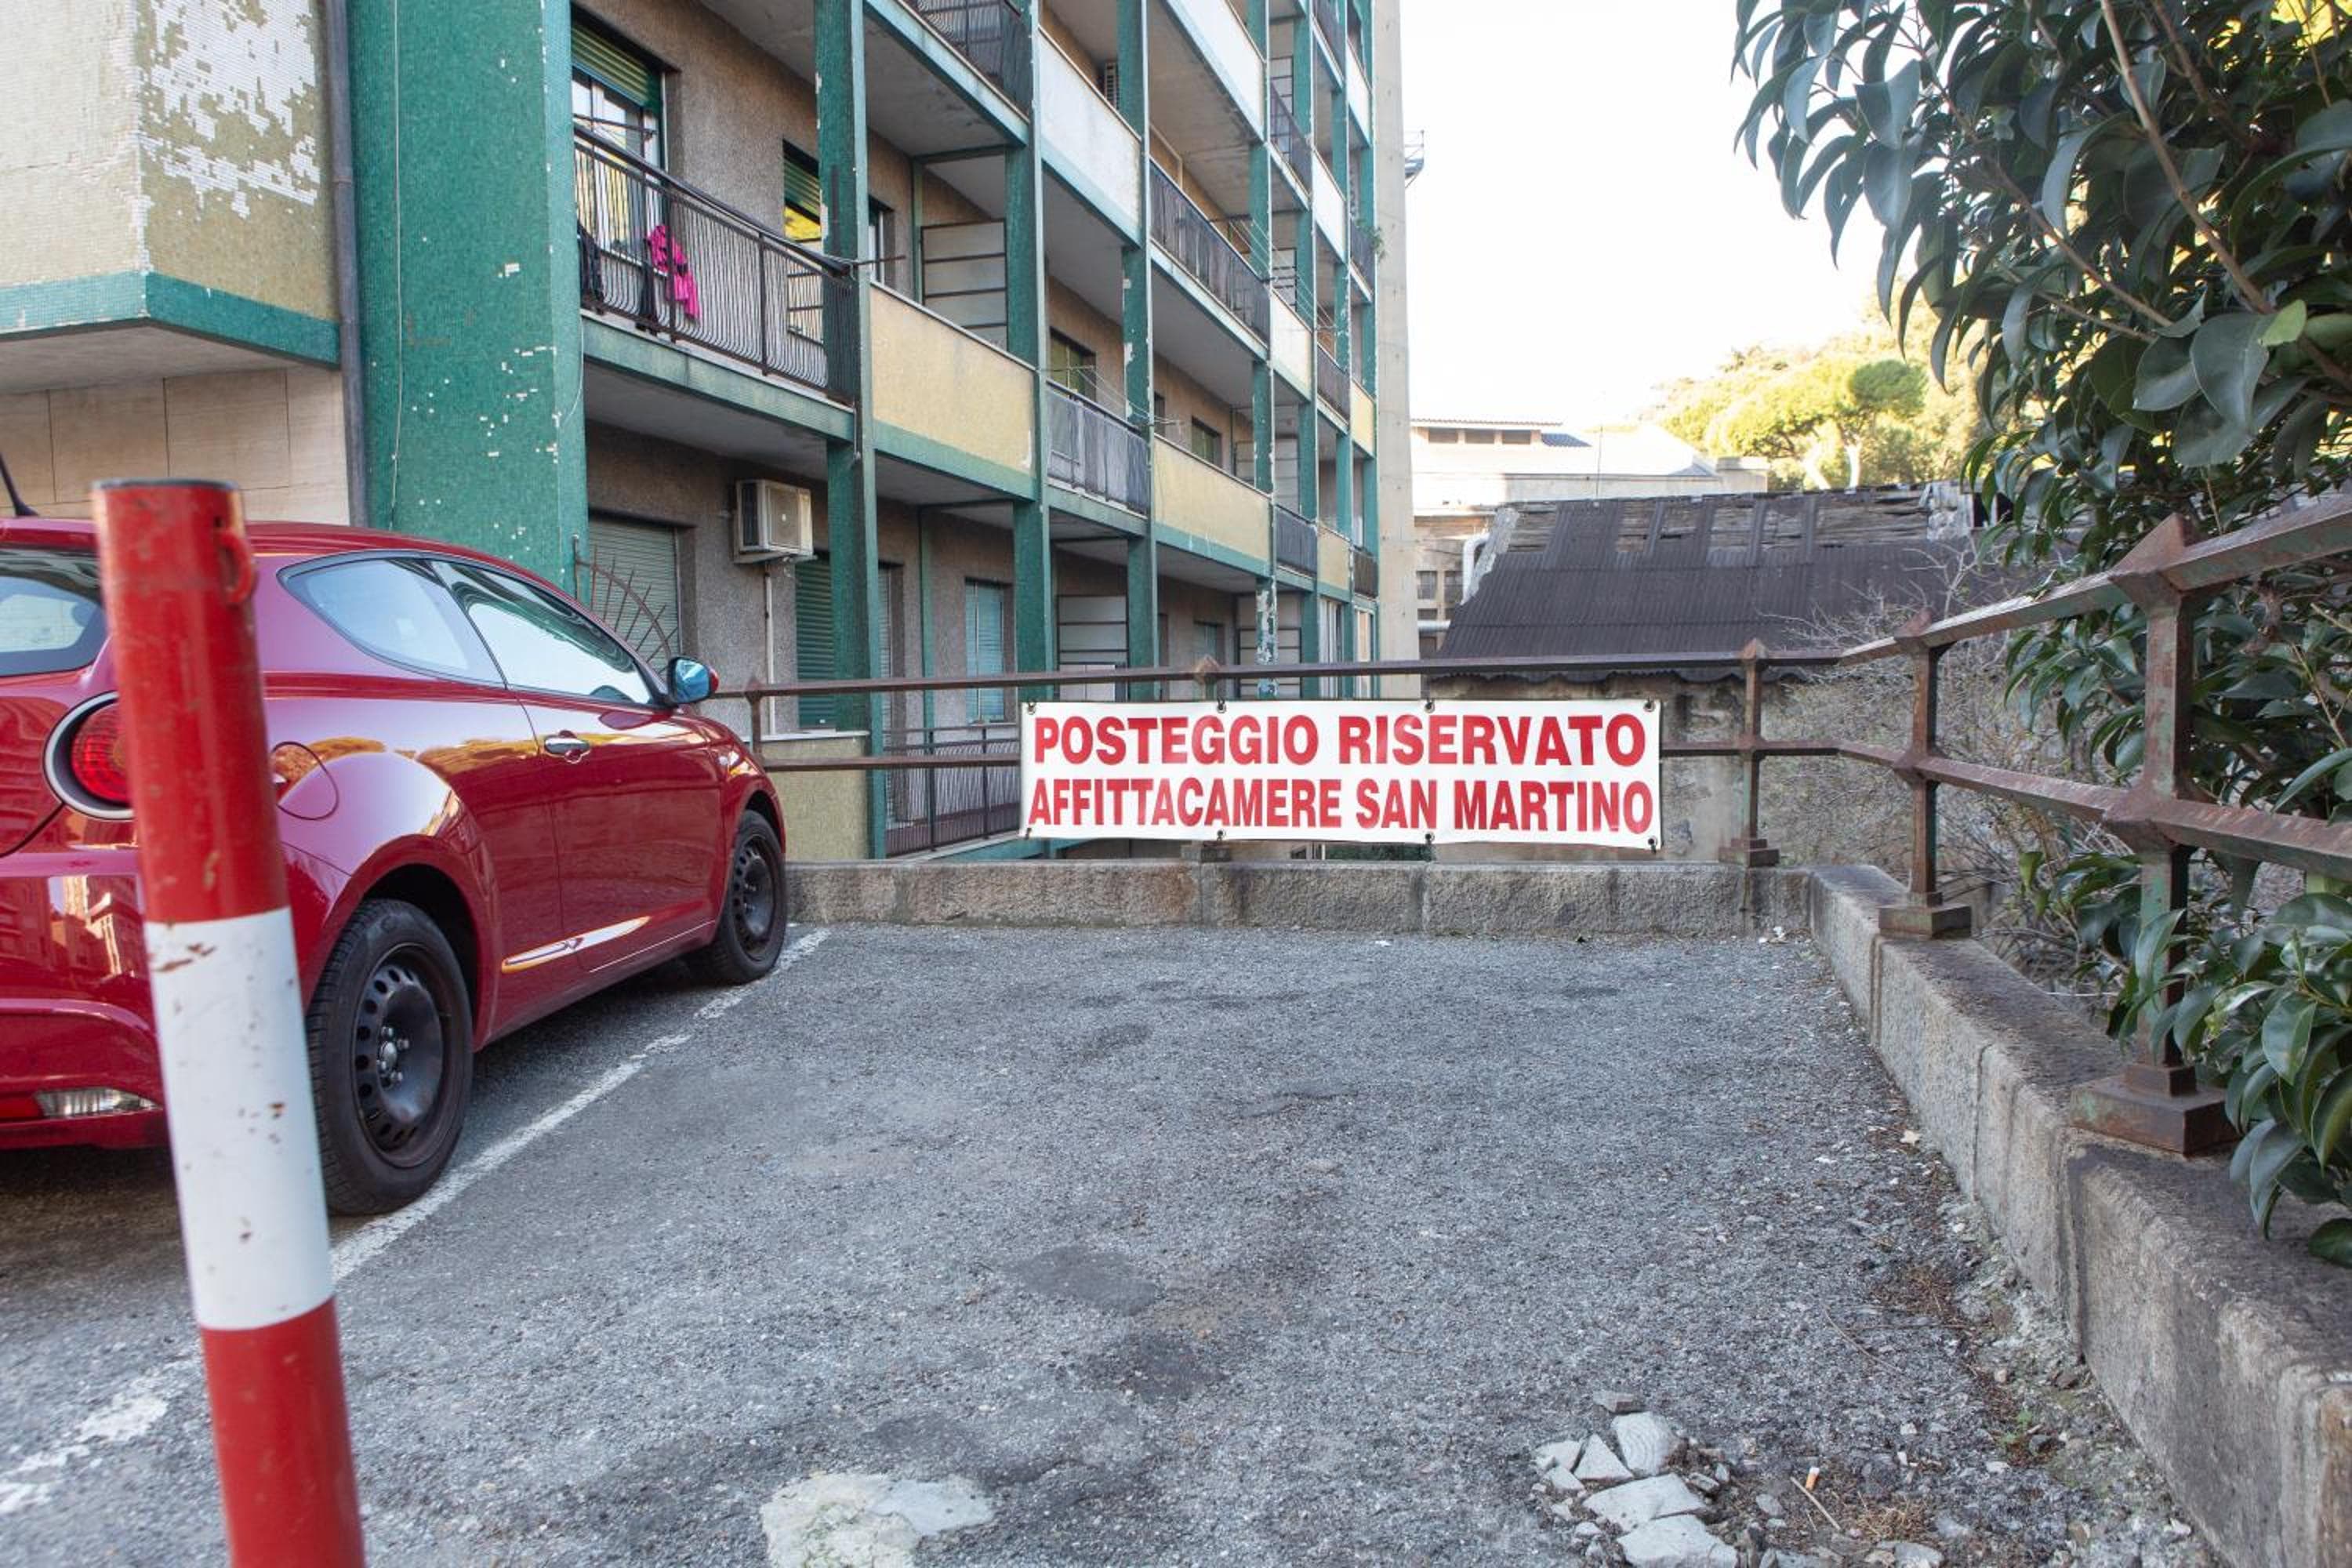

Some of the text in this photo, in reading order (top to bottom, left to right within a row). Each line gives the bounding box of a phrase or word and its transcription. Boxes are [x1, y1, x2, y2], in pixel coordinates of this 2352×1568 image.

[1034, 713, 1646, 767] POSTEGGIO RISERVATO
[1028, 777, 1653, 833] AFFITTACAMERE SAN MARTINO
